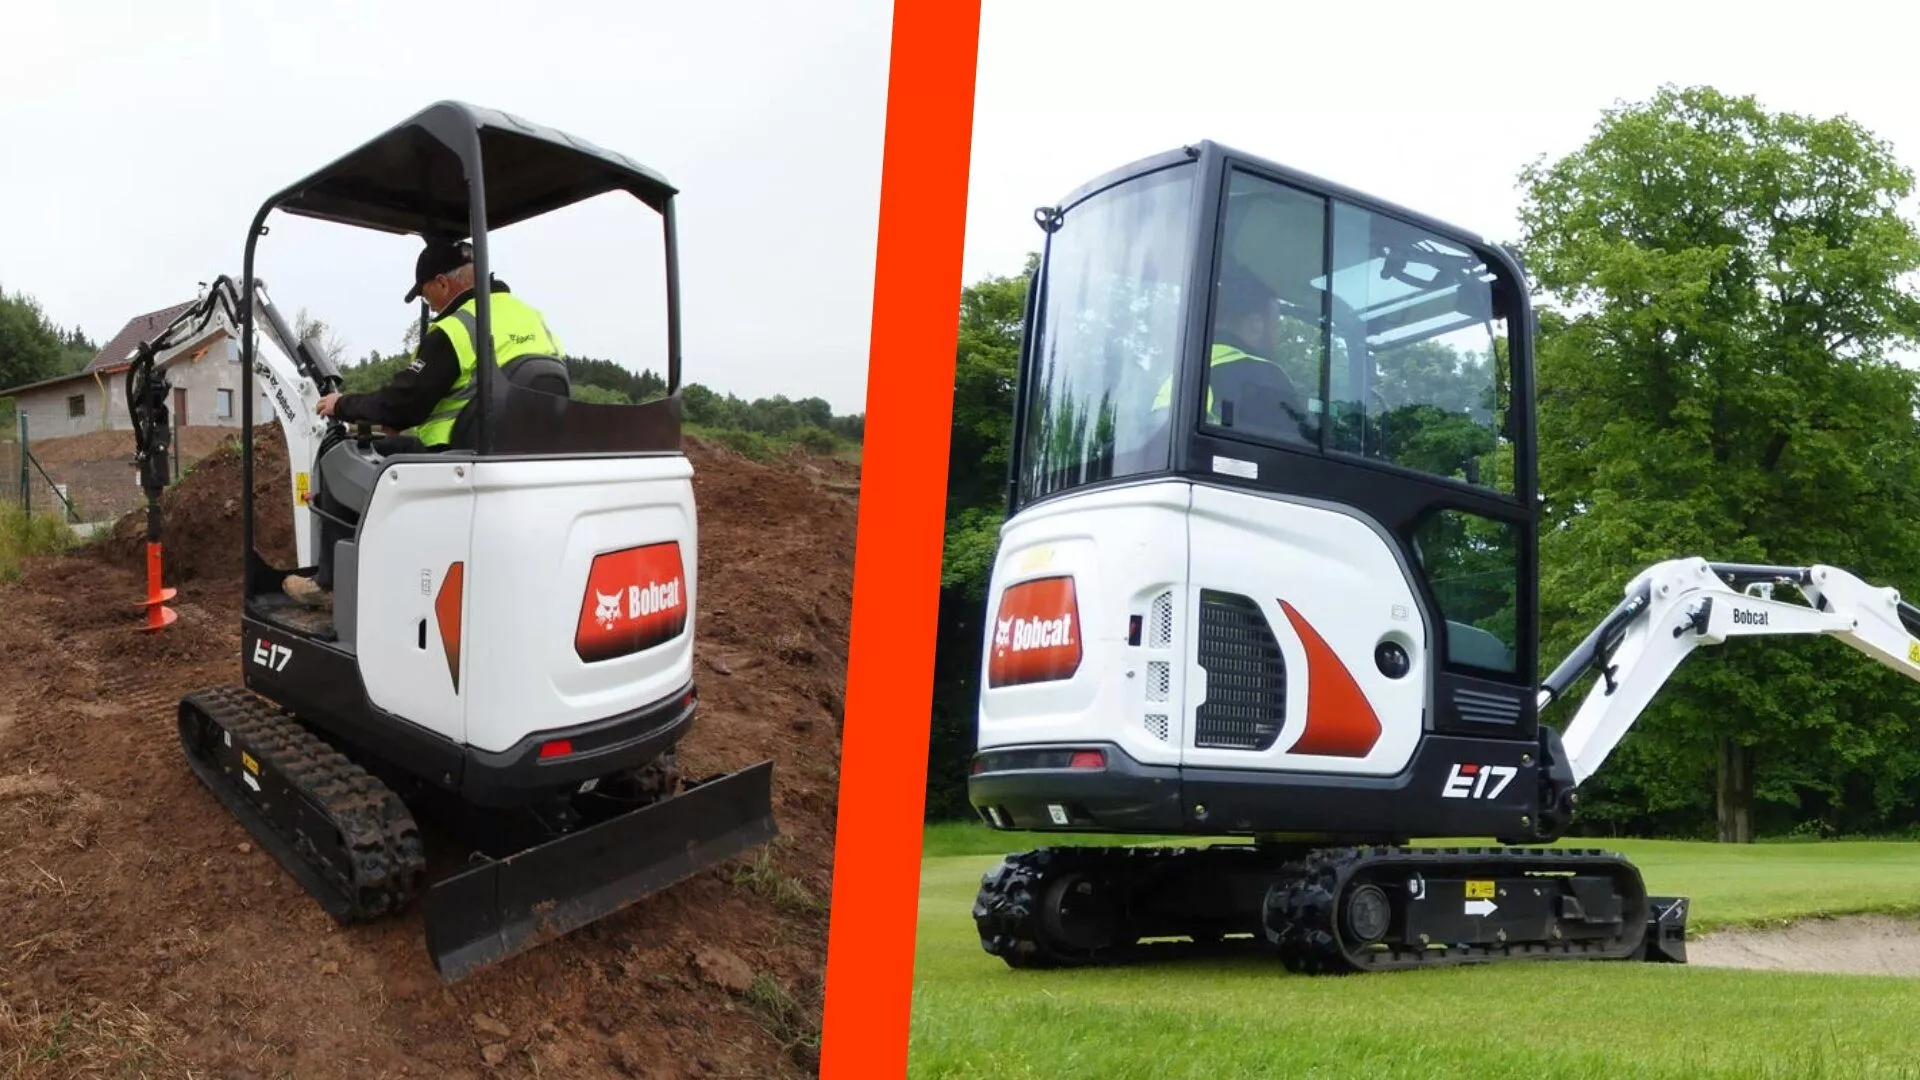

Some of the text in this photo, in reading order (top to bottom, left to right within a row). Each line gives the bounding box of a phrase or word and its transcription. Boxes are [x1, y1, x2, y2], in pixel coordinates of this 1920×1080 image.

[628, 576, 680, 620] Bobcat
[1012, 613, 1071, 652] Bobcat
[1733, 608, 1769, 626] Bobcat
[253, 638, 293, 672] E17
[1441, 763, 1518, 800] E17
